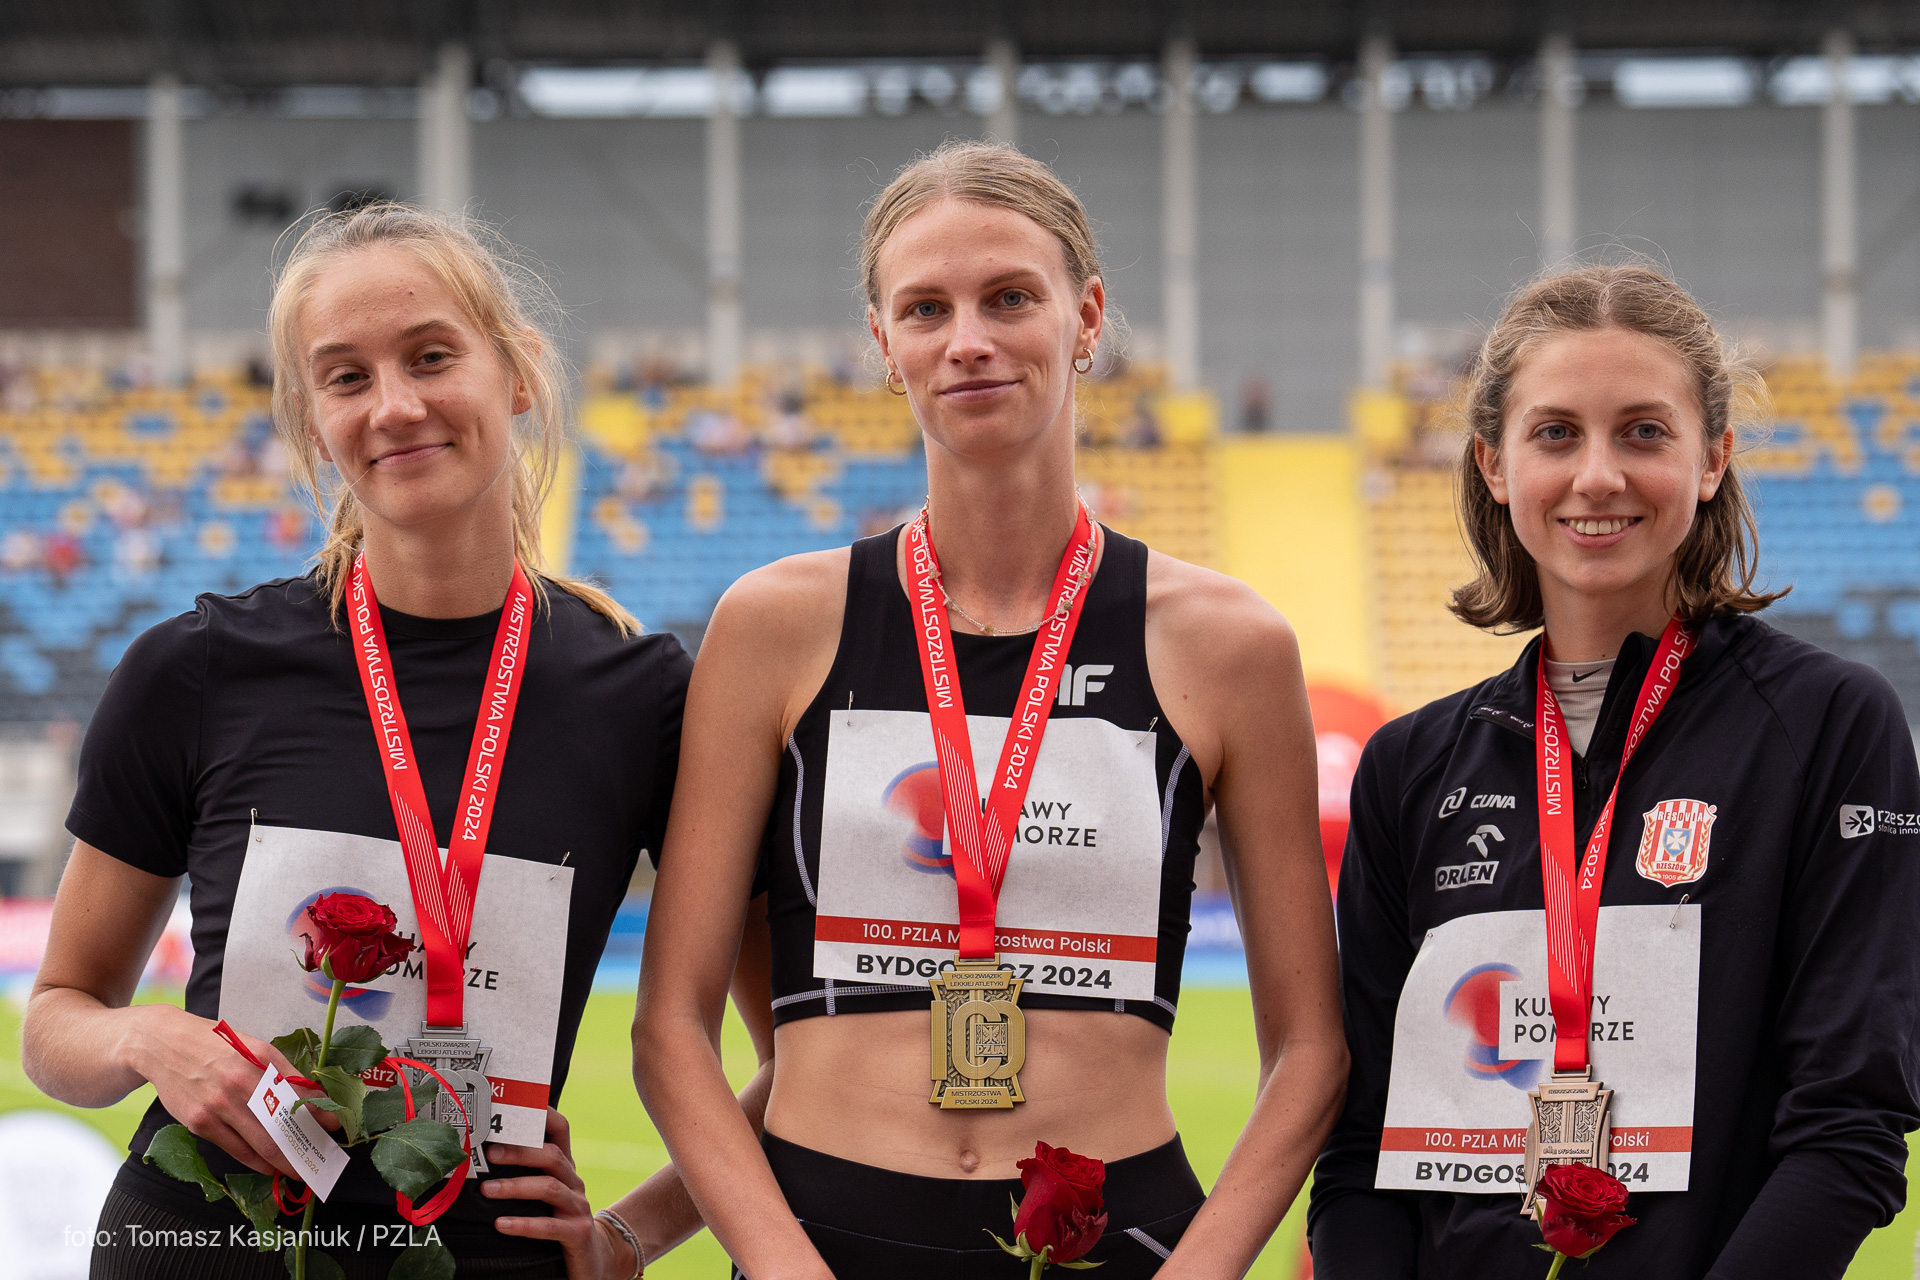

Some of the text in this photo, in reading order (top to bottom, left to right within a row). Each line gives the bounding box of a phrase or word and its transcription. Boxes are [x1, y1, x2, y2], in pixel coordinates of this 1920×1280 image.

[353, 572, 374, 635] POLSKI
[918, 576, 953, 709] MISTRZOSTWA
[1660, 625, 1692, 683] POLSK
[363, 634, 407, 770] MISTRZOSTWA
[462, 592, 526, 841] MISTRZOSTWA POLSKI 2024
[1017, 674, 1049, 741] POLSKI
[1003, 742, 1028, 790] 2024
[1544, 690, 1561, 815] MISTRZOSTWA
[1470, 794, 1516, 809] CUNA
[1658, 811, 1703, 821] RESOVIA
[1899, 827, 1920, 835] inno
[1437, 864, 1495, 887] ORLEN
[1581, 843, 1601, 890] 2024
[1656, 862, 1687, 872] RZESZÓW
[863, 923, 896, 940] 100.
[901, 926, 942, 943] PZLA
[1060, 937, 1111, 954] Polski
[1041, 964, 1112, 989] 2024
[976, 1045, 1005, 1055] PZLA
[275, 1116, 319, 1175] BYDGOSZCZ 2024
[1425, 1132, 1456, 1147] 100.
[1461, 1134, 1499, 1148] PZLA
